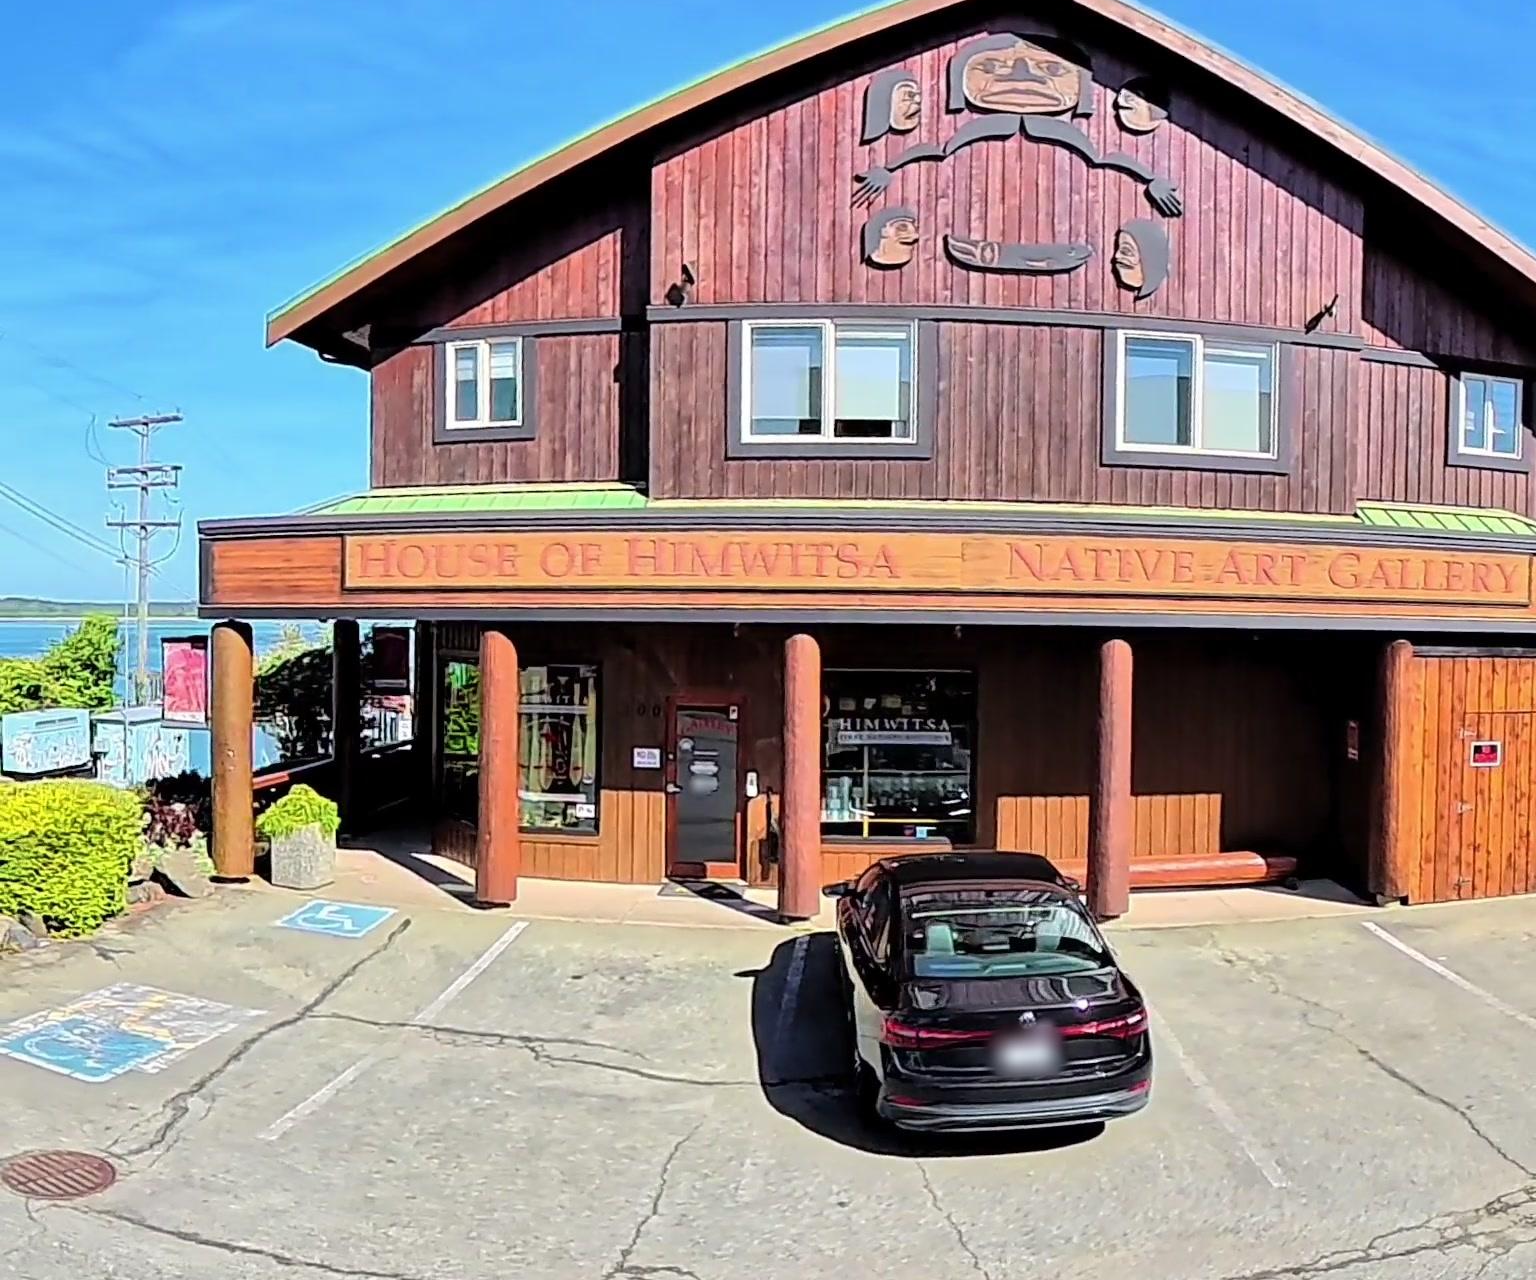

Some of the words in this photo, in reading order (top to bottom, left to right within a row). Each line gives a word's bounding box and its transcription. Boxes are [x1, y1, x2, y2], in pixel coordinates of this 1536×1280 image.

[357, 539, 519, 579] HOUSE
[540, 541, 602, 578] OF
[623, 538, 902, 579] HIMWITSA
[1005, 541, 1196, 583] NATIVE
[1214, 549, 1308, 587] ART
[1328, 551, 1520, 594] GALLERY
[839, 718, 950, 731] HIMWITSA
